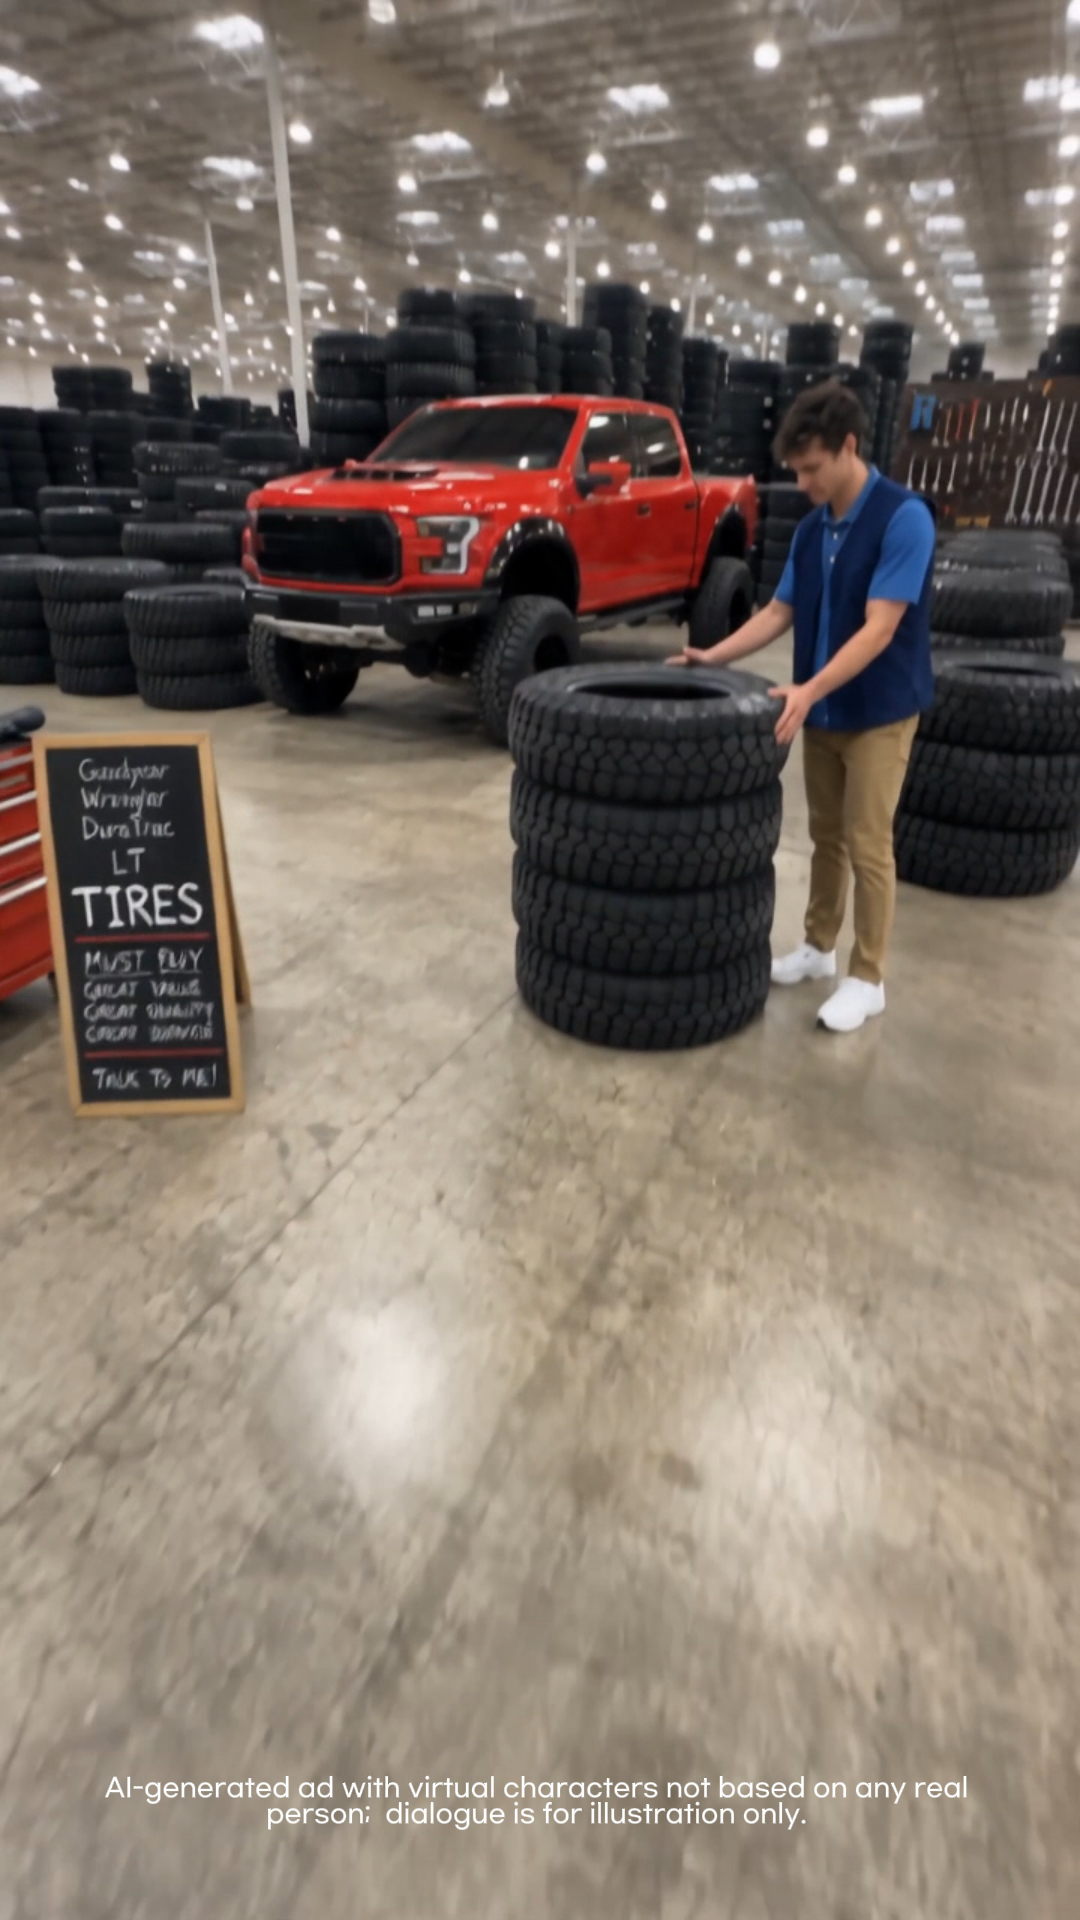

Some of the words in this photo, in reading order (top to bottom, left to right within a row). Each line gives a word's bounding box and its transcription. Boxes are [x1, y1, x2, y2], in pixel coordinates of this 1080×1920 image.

[112, 847, 145, 875] LT
[71, 882, 203, 928] TIRES
[85, 950, 145, 975] MUST
